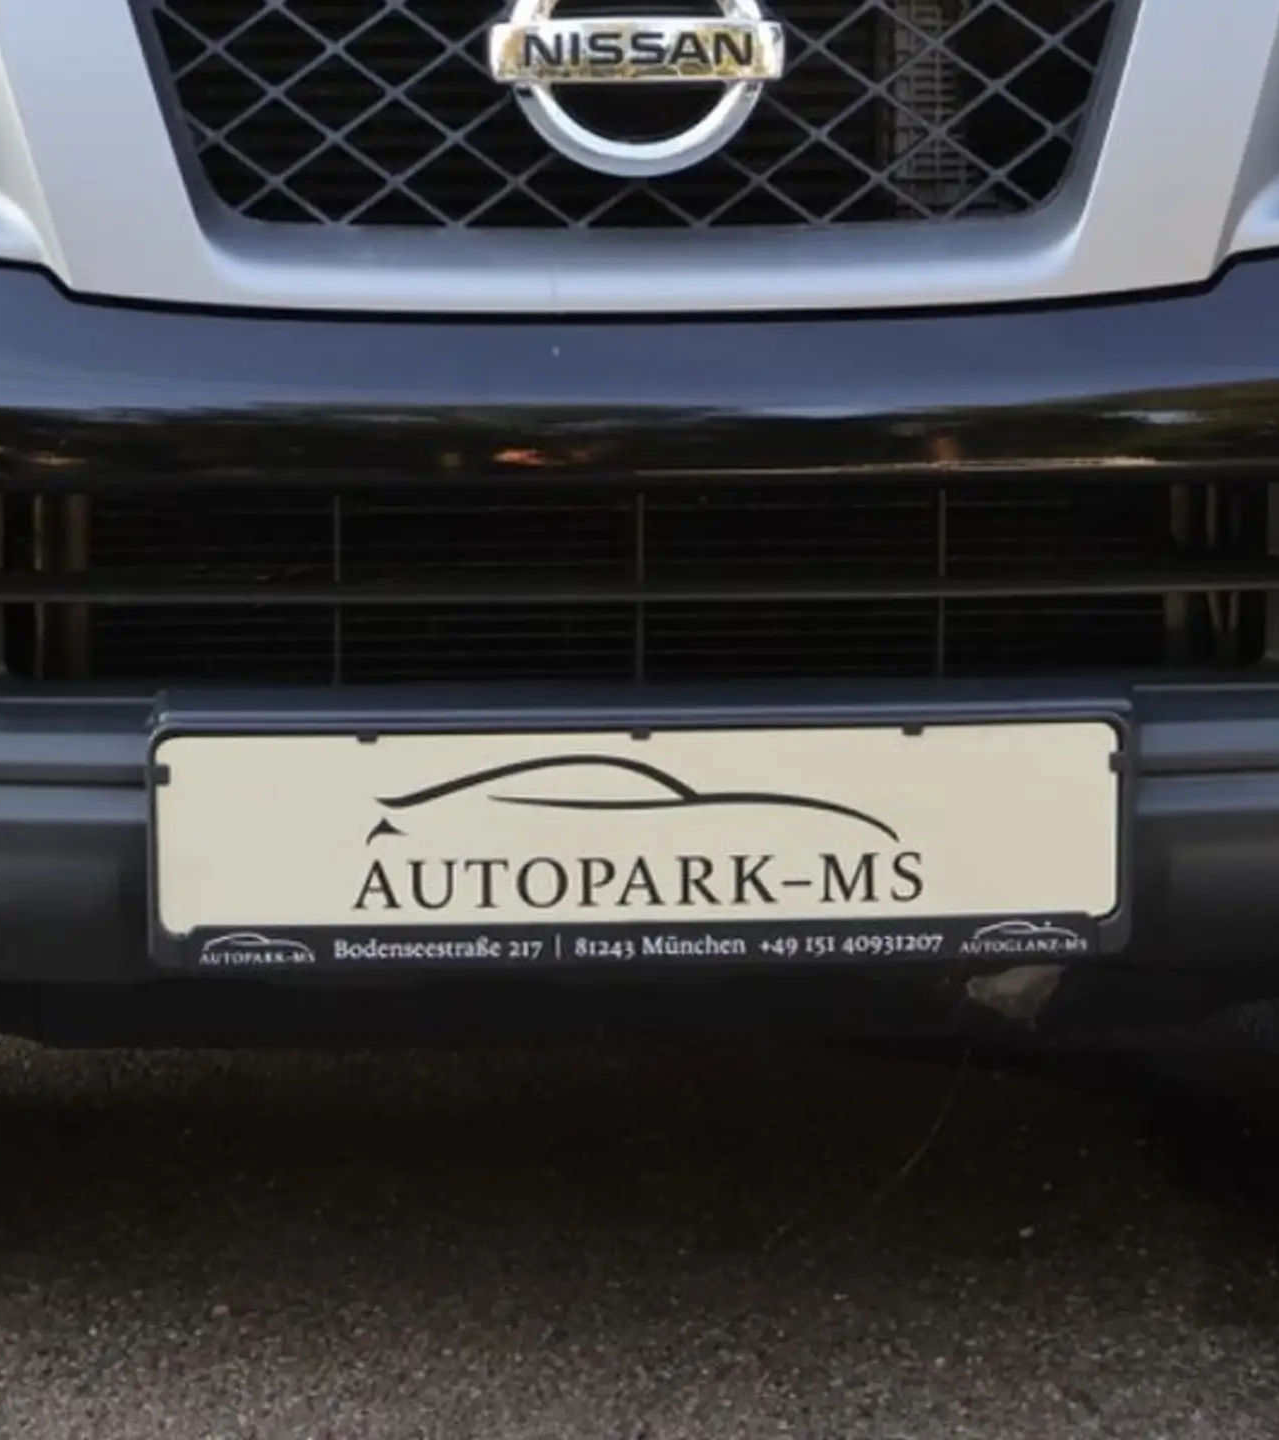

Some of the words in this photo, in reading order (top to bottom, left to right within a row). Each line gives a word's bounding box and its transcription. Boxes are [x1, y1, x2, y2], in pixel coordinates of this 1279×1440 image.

[523, 31, 753, 66] NISSAN
[352, 851, 924, 910] AUTOPARK-MS
[333, 936, 502, 960] Bodenseestraße
[509, 940, 543, 960] 217
[574, 936, 635, 958] 81243
[641, 933, 746, 956] München
[759, 936, 798, 957] +49
[805, 935, 835, 957] 151
[842, 933, 944, 956] 40931207
